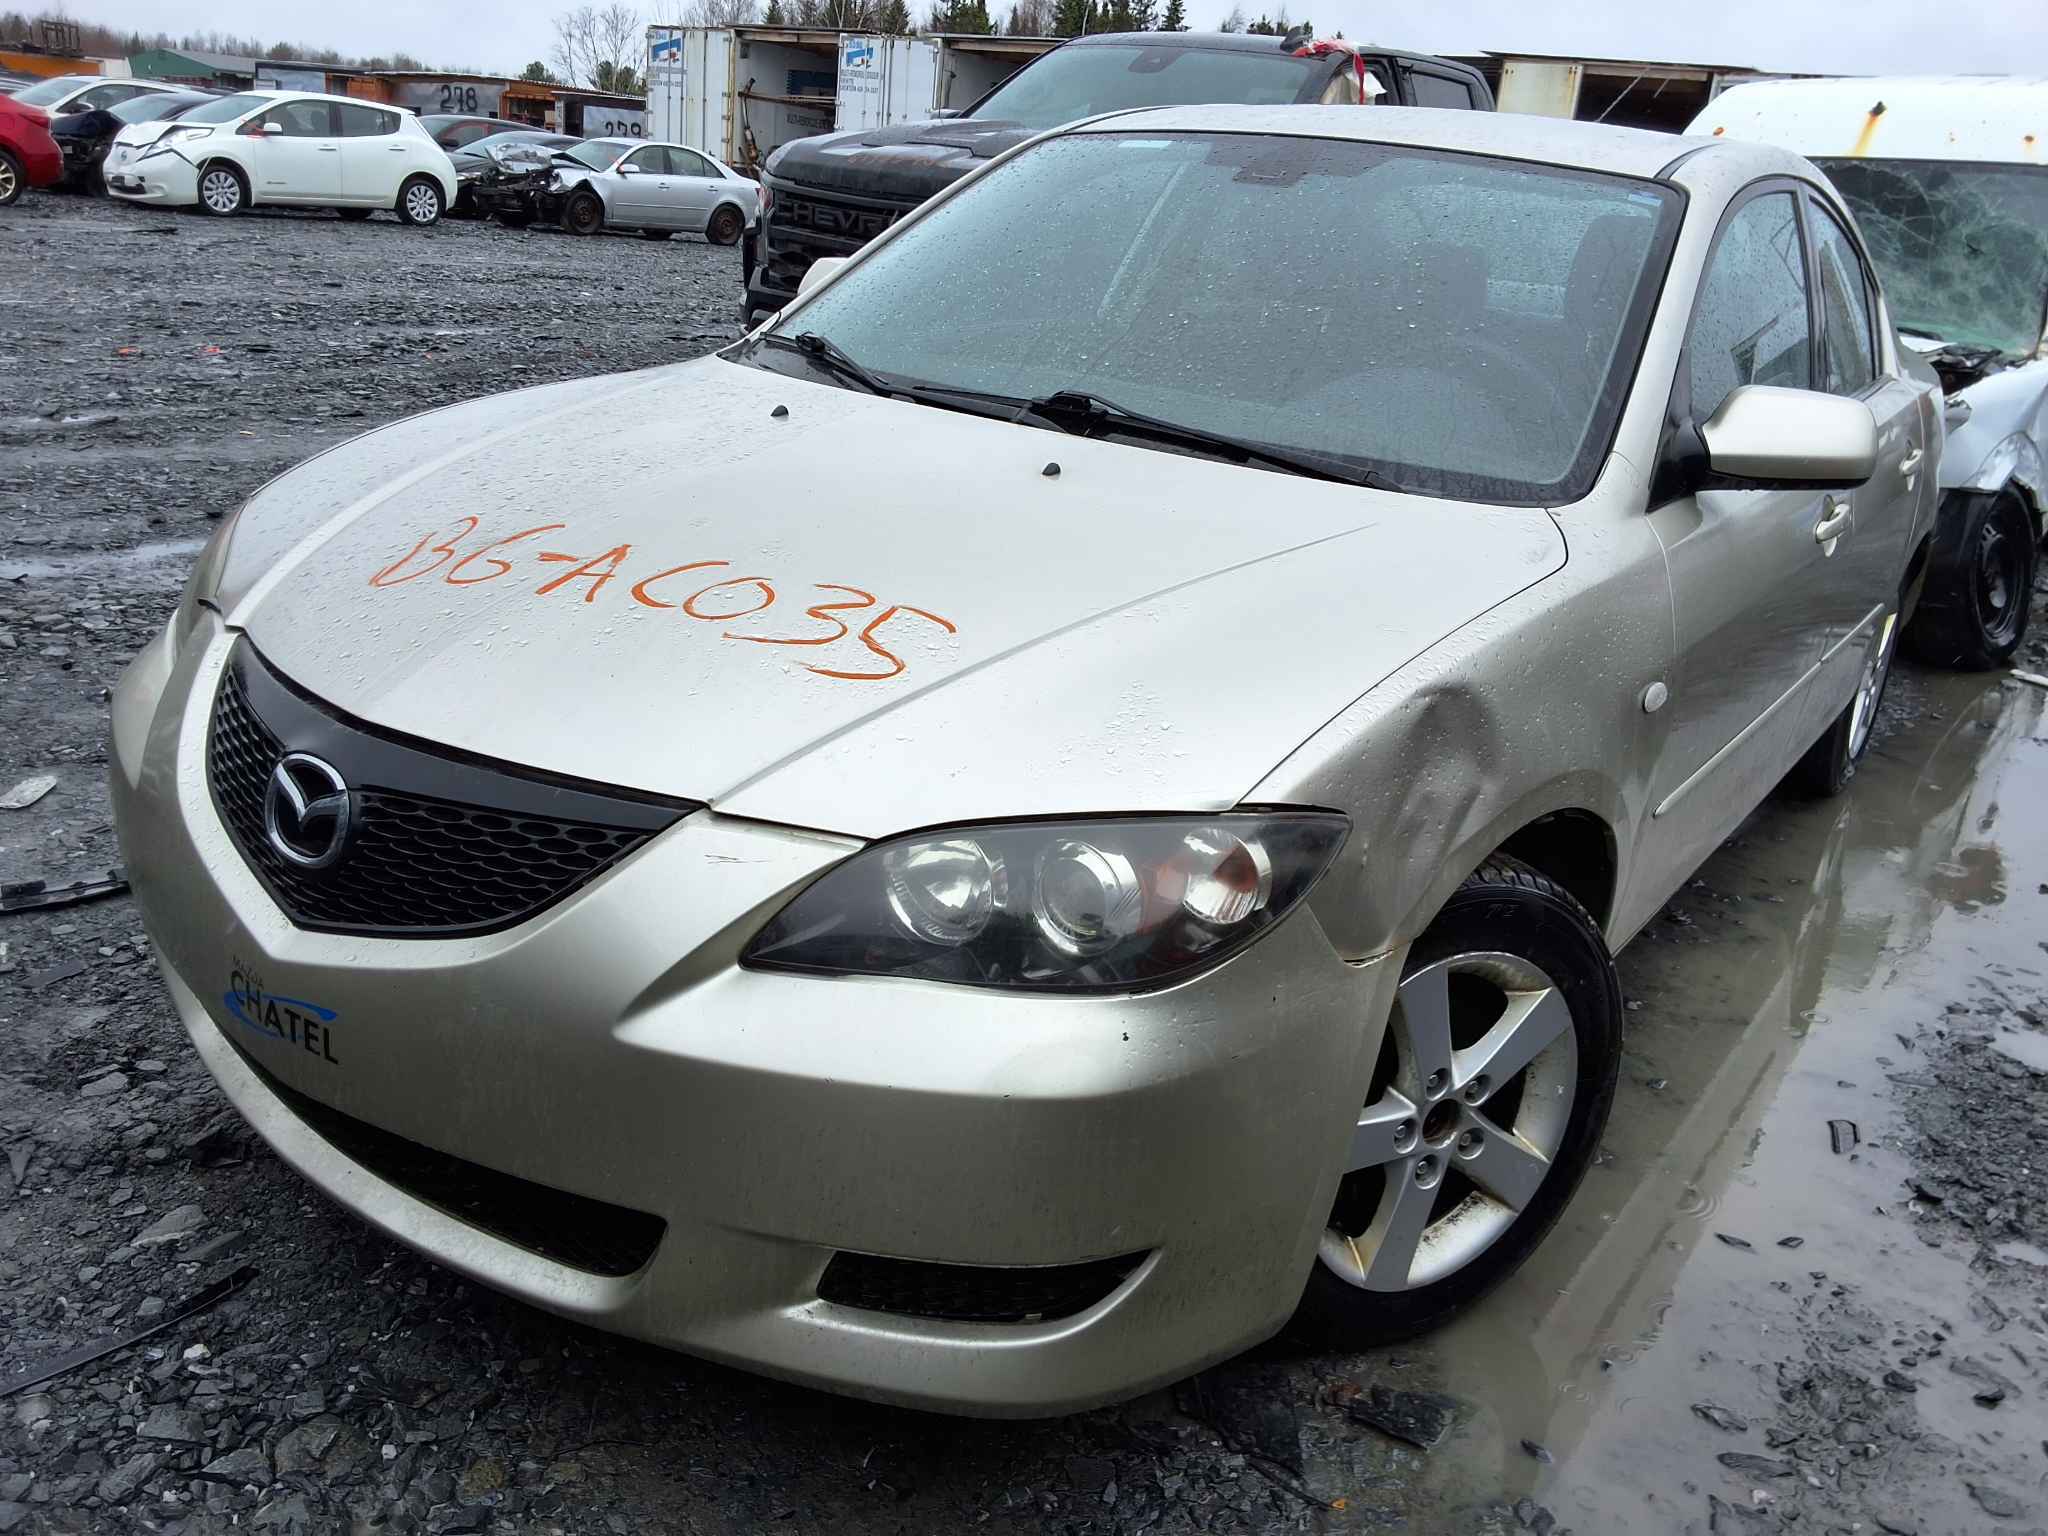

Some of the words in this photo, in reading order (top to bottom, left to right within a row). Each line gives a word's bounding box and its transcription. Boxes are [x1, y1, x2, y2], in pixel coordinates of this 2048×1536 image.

[440, 84, 478, 112] 278
[779, 200, 897, 235] CHEVR
[230, 970, 339, 1065] CHATEL
